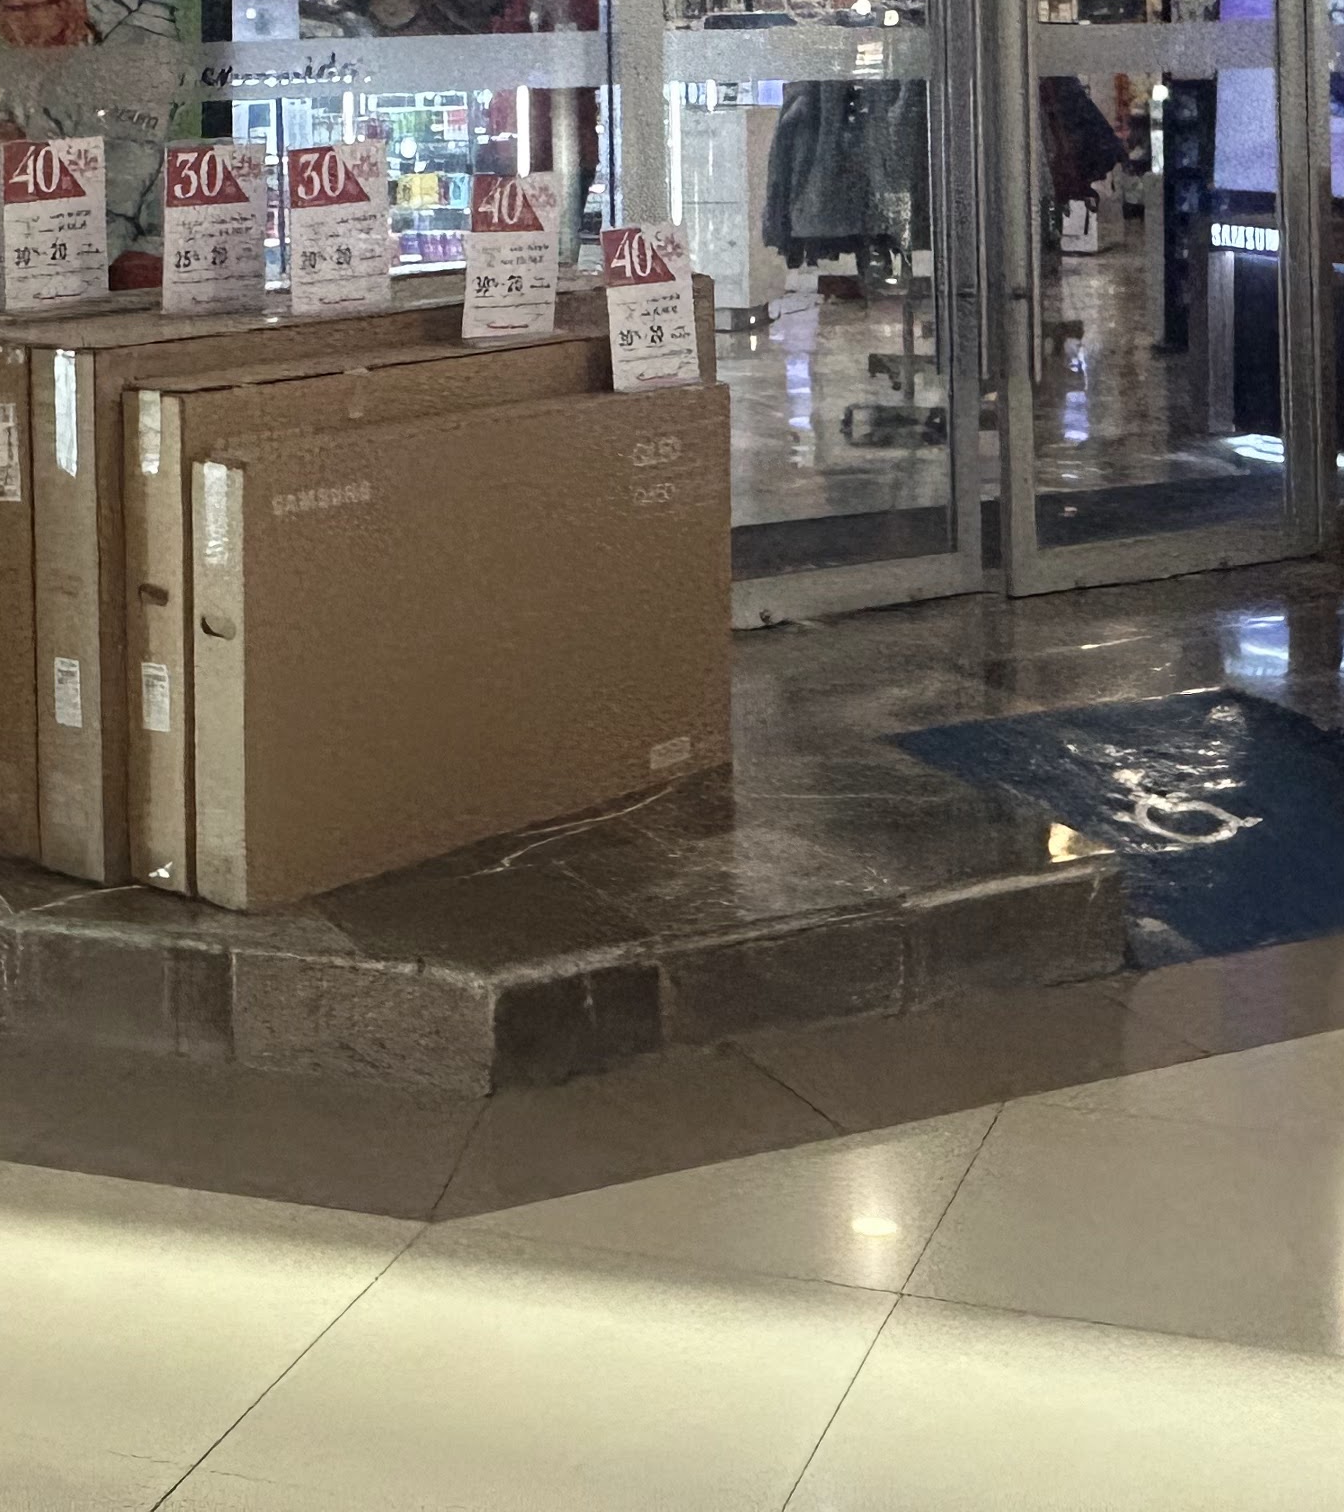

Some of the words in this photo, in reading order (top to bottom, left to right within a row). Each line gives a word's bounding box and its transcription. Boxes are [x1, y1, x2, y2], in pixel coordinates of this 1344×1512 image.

[8, 145, 61, 194] 40
[173, 149, 225, 199] 30
[297, 150, 346, 200] 30
[477, 174, 524, 225] 40
[610, 231, 654, 279] 40
[1210, 222, 1280, 252] SAMSUN
